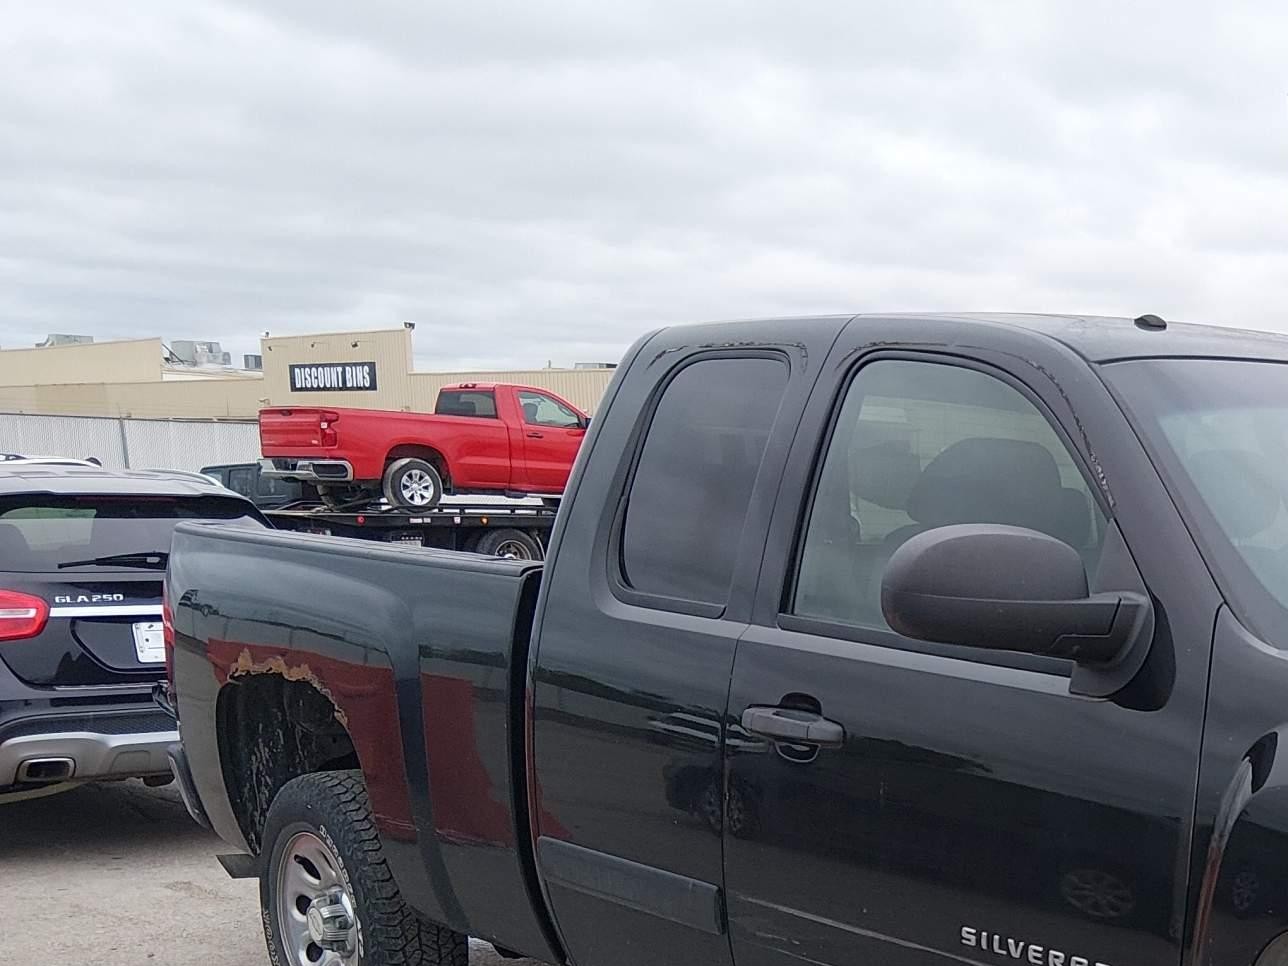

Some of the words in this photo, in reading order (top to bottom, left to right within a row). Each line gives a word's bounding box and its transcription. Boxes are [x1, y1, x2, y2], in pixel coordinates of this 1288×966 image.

[294, 367, 343, 389] DISCOUNT
[345, 365, 371, 388] BINS
[54, 595, 89, 603] GLA
[91, 593, 124, 602] 250
